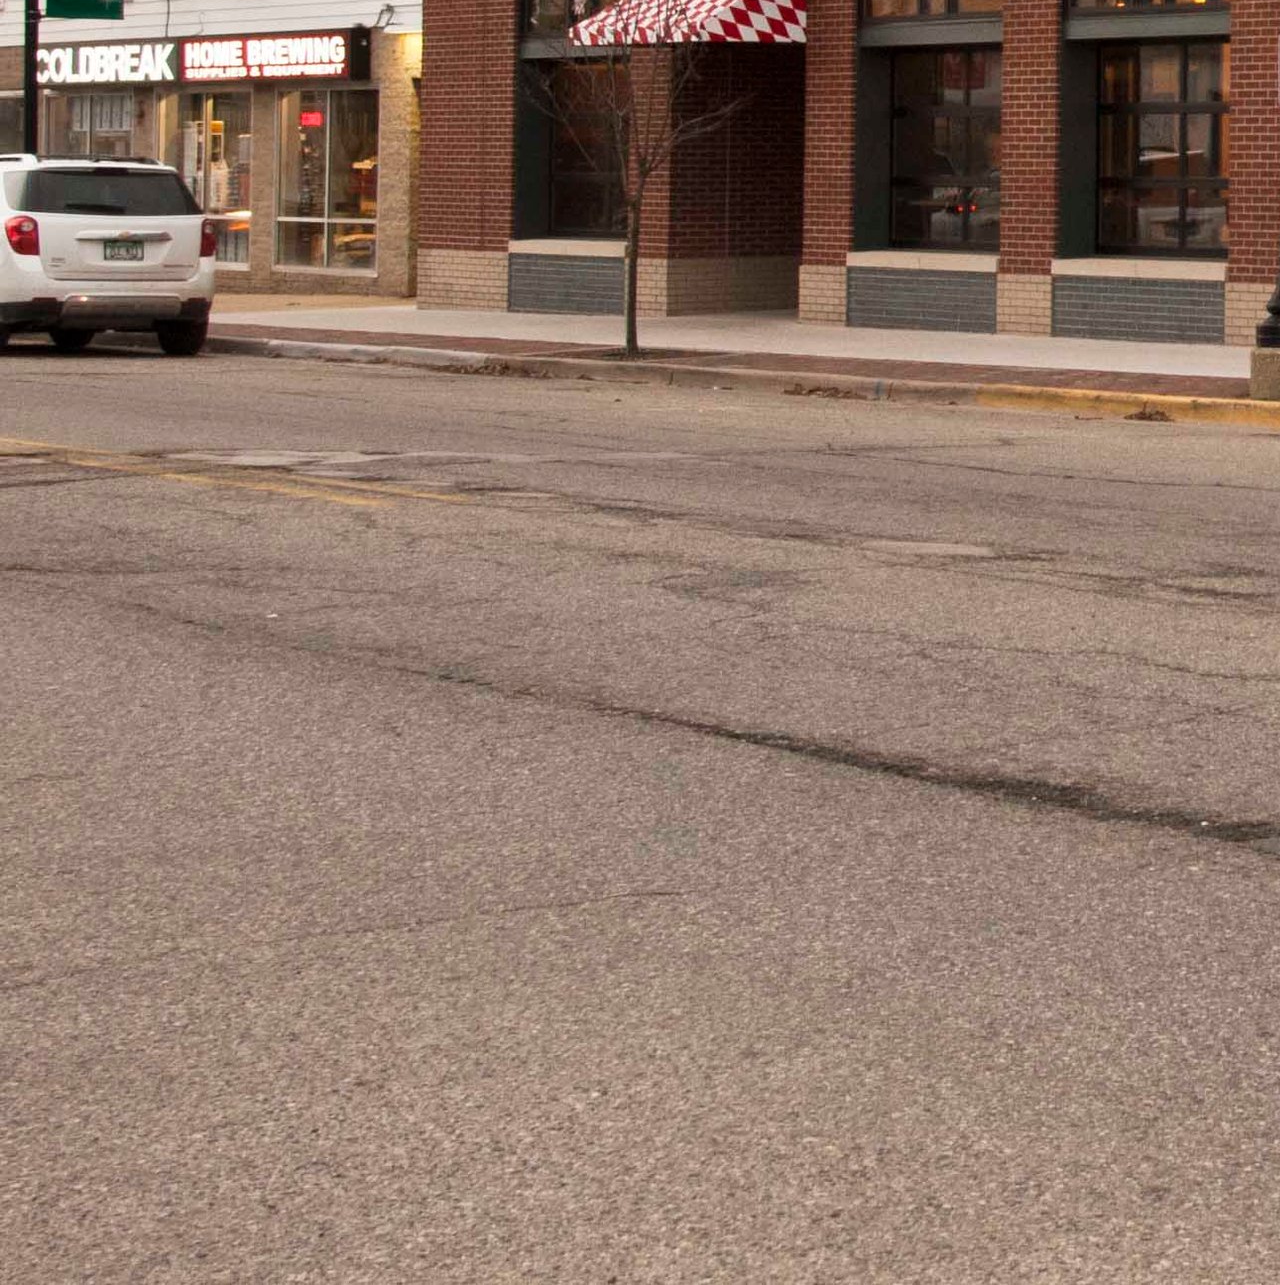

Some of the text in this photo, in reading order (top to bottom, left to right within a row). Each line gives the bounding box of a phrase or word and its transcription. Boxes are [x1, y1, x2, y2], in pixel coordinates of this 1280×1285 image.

[37, 36, 346, 83] COLDBREAK HOME BREWING
[185, 64, 345, 79] SUPPLIES & EQUIPMENT
